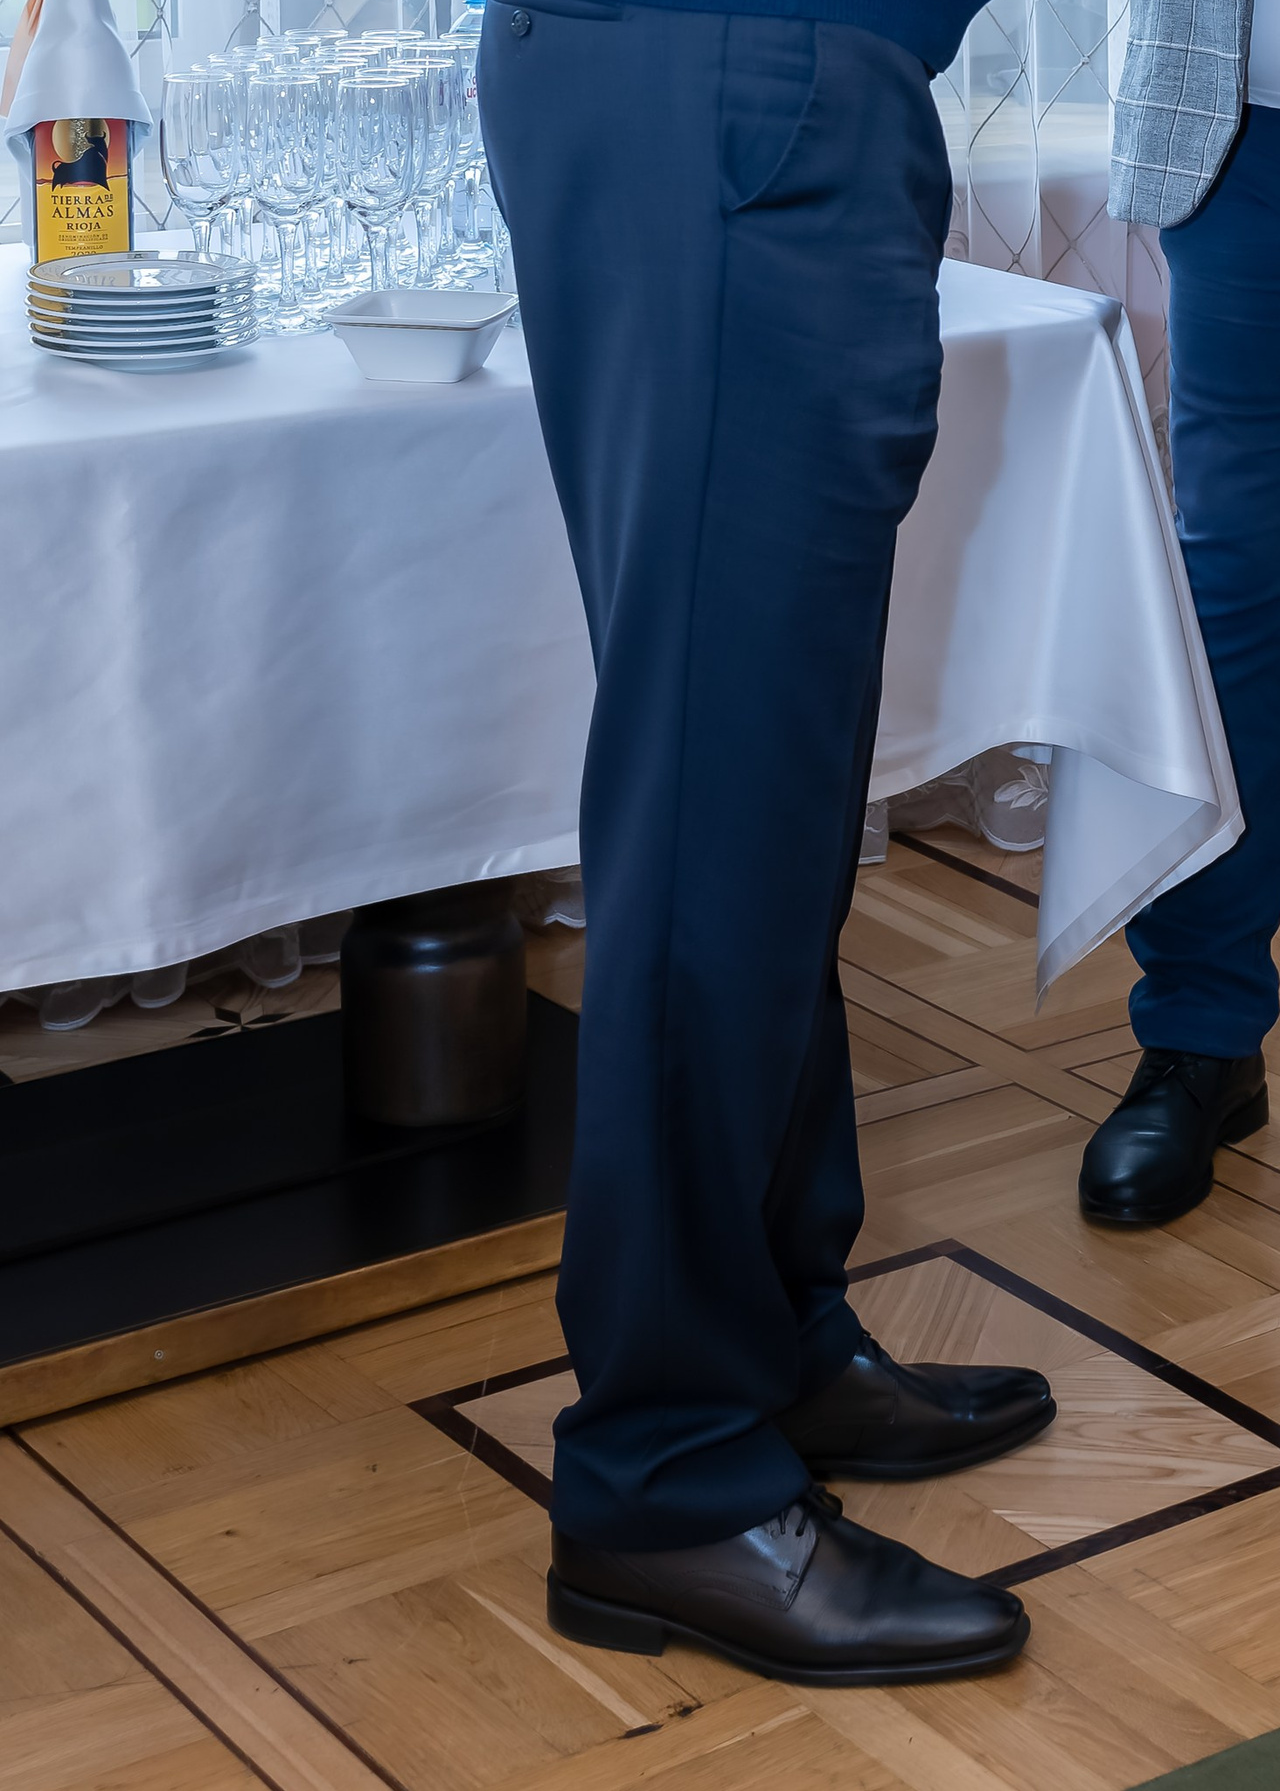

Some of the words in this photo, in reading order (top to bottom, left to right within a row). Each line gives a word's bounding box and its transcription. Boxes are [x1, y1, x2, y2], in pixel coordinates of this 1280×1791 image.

[51, 195, 104, 205] TIERRA
[52, 205, 114, 218] ALMAS
[67, 222, 101, 232] RIOJA
